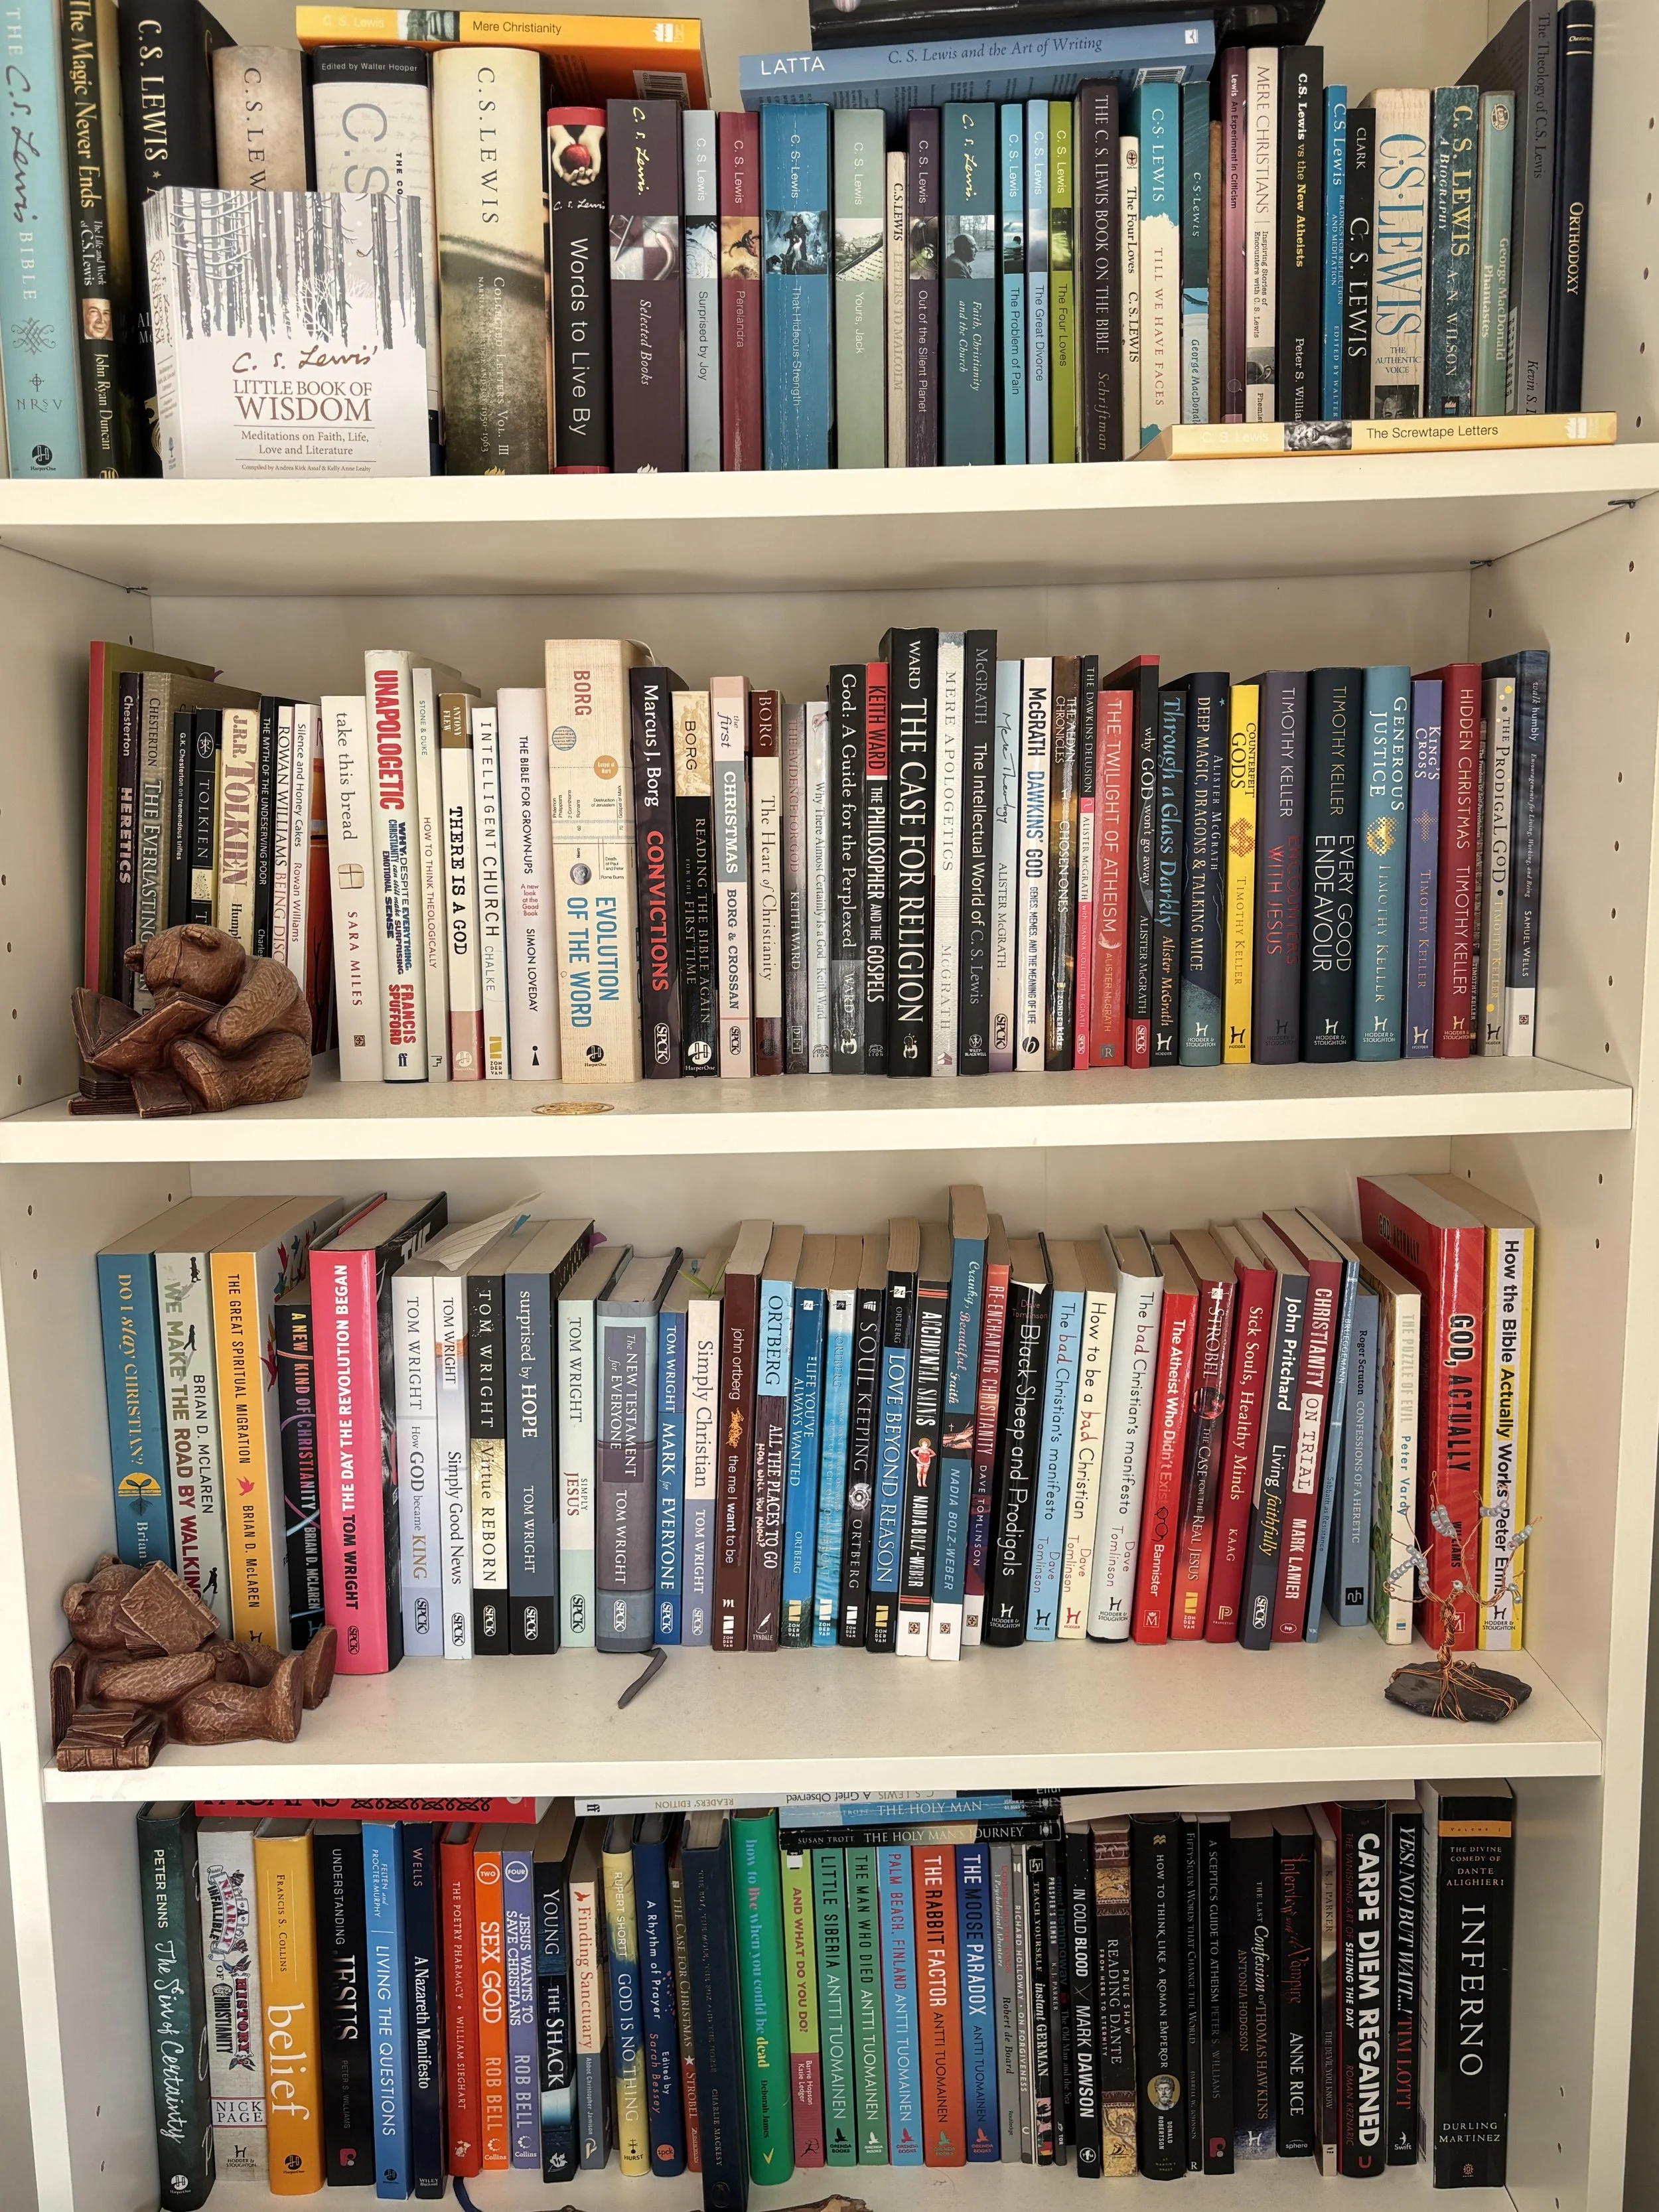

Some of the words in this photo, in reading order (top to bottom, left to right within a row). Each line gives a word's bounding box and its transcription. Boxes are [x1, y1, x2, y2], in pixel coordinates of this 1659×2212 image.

[137, 19, 163, 67] C.S.
[472, 21, 500, 33] Mere
[502, 22, 561, 35] Christianity
[70, 38, 90, 94] Magic
[321, 62, 346, 72] Edited
[360, 62, 386, 72] Walter
[388, 62, 417, 72] Hooper
[761, 56, 825, 75] LATTA
[888, 51, 902, 63] C.
[905, 50, 917, 62] S.
[922, 47, 957, 61] Lewis
[961, 44, 985, 58] and
[988, 42, 1008, 56] the
[1012, 40, 1033, 54] Art
[1037, 39, 1048, 54] of
[1051, 37, 1103, 53] Writing
[1257, 67, 1270, 108] MERE
[76, 102, 92, 159] Never
[140, 75, 168, 161] LEWIS
[1256, 115, 1269, 213] CHRISTIANS
[79, 167, 96, 207] Ends
[1567, 202, 1584, 295] ORTHODOXY
[571, 238, 589, 311] Words
[697, 292, 708, 342] Surprised
[855, 293, 864, 325] Yours,
[571, 321, 588, 341] to
[855, 329, 865, 353] Jack
[697, 346, 709, 358] by
[697, 362, 709, 380] Joy
[233, 379, 293, 396] LITTLE
[296, 380, 345, 396] BOOK
[348, 382, 372, 396] OF
[572, 352, 589, 397] Live
[238, 398, 372, 421] WISDOM
[569, 409, 590, 435] By
[242, 431, 299, 442] Meditations
[318, 431, 344, 443] Faith,
[348, 432, 369, 443] Life,
[259, 444, 282, 455] Love
[285, 443, 303, 456] and
[305, 445, 353, 456] Literature
[1366, 428, 1388, 438] The
[1392, 426, 1455, 439] Screwtape
[1458, 425, 1498, 436] Letters
[574, 671, 591, 716] BORG
[336, 713, 352, 746] take
[644, 686, 658, 747] Marcus
[900, 698, 927, 753] THE
[1459, 690, 1473, 749] HIDDEN
[374, 670, 405, 810] UNAPOLOGETIC
[643, 752, 661, 761] J.
[1230, 732, 1246, 789] GODS
[1245, 723, 1256, 798] COUNTERFEIT
[1368, 711, 1387, 798] JUSTICE
[1390, 697, 1407, 811] GENEROUS
[338, 754, 354, 784] this
[644, 768, 661, 806] Borg
[899, 762, 926, 825] CASE
[1457, 757, 1472, 848] CHRISTMAS
[340, 792, 358, 840] bread
[724, 771, 739, 873] CHRISTMAS
[449, 806, 465, 869] THERE
[899, 836, 925, 889] FOR
[1338, 836, 1354, 894] EVERY
[452, 875, 465, 895] IS
[1313, 835, 1333, 972] ENDEAVOUR
[453, 902, 466, 913] A
[567, 897, 588, 921] OF
[647, 831, 669, 991] CONVICTIONS
[1523, 911, 1532, 944] SAMUEL
[453, 920, 467, 954] GOD
[569, 928, 590, 963] THE
[596, 897, 619, 1001] EVOLUTION
[1336, 904, 1352, 971] GOOD
[898, 896, 924, 1021] RELIGION
[1522, 948, 1530, 976] WELLS
[570, 972, 592, 1027] WORD
[1504, 1241, 1520, 1279] How
[228, 1274, 241, 1294] THE
[334, 1264, 348, 1316] BEGAN
[1503, 1285, 1518, 1313] the
[230, 1301, 243, 1335] GREAT
[518, 1291, 536, 1361] surprised
[1089, 1303, 1106, 1339] How
[1285, 1297, 1301, 1333] John
[1087, 1347, 1100, 1361] to
[1356, 1331, 1368, 1357] Roger
[1501, 1319, 1516, 1362] Bible
[232, 1341, 246, 1398] SPIRITUAL
[336, 1320, 352, 1416] REVOLUTION
[520, 1367, 532, 1378] by
[886, 1355, 906, 1405] LOVE
[1085, 1370, 1101, 1386] be
[1277, 1339, 1297, 1410] Pritchard
[1357, 1359, 1366, 1395] Scruton
[522, 1384, 538, 1438] HOPE
[1498, 1368, 1514, 1438] Actually
[236, 1404, 250, 1463] MIGRATION
[340, 1420, 353, 1447] THE
[768, 1424, 783, 1447] ALL
[1080, 1411, 1097, 1441] bad
[340, 1450, 355, 1479] DAY
[446, 1451, 463, 1498] Simply
[767, 1451, 782, 1477] THE
[881, 1413, 902, 1497] BEYOND
[342, 1485, 354, 1512] THE
[766, 1481, 780, 1526] PLACES
[1074, 1448, 1094, 1518] Christian
[449, 1503, 465, 1540] Good
[762, 1530, 779, 1547] TO
[1290, 1518, 1306, 1552] MARK
[763, 1552, 778, 1568] GO
[877, 1505, 897, 1582] REASON
[451, 1546, 464, 1584] News
[1285, 1558, 1303, 1598] LANIER
[154, 1850, 167, 1889] PETER
[822, 1857, 837, 1904] LITTLE
[924, 1856, 942, 1885] THE
[1356, 1834, 1382, 1921] CARPE
[157, 1894, 169, 1928] ENNS
[506, 1911, 518, 1943] SAVE
[519, 1913, 531, 1950] JESUS
[925, 1890, 944, 1944] RABBIT
[415, 1956, 429, 1965] A
[480, 1922, 500, 1963] SEX
[824, 1915, 840, 1968] SIBERIA
[376, 1947, 391, 2000] LIVING
[520, 1955, 533, 2001] WANTS
[928, 1950, 946, 2006] FACTOR
[1356, 1930, 1381, 2002] DIEM
[415, 1969, 430, 2024] Nazareth
[482, 1971, 502, 2023] GOD
[508, 1948, 522, 2026] CHRISTIANS
[547, 1986, 560, 2013] THE
[1460, 1904, 1486, 2077] INFERNO
[378, 2008, 392, 2035] THE
[522, 2005, 534, 2023] TO
[267, 2003, 310, 2120] belief
[417, 2029, 431, 2089] Manifesto
[546, 2019, 564, 2087] SHACK
[380, 2043, 396, 2135] QUESTIONS
[1356, 2008, 1382, 2148] REGAINED
[216, 2101, 261, 2112] NICK
[217, 2112, 263, 2122] PAGE
[1439, 2134, 1500, 2142] MARTINEZ
